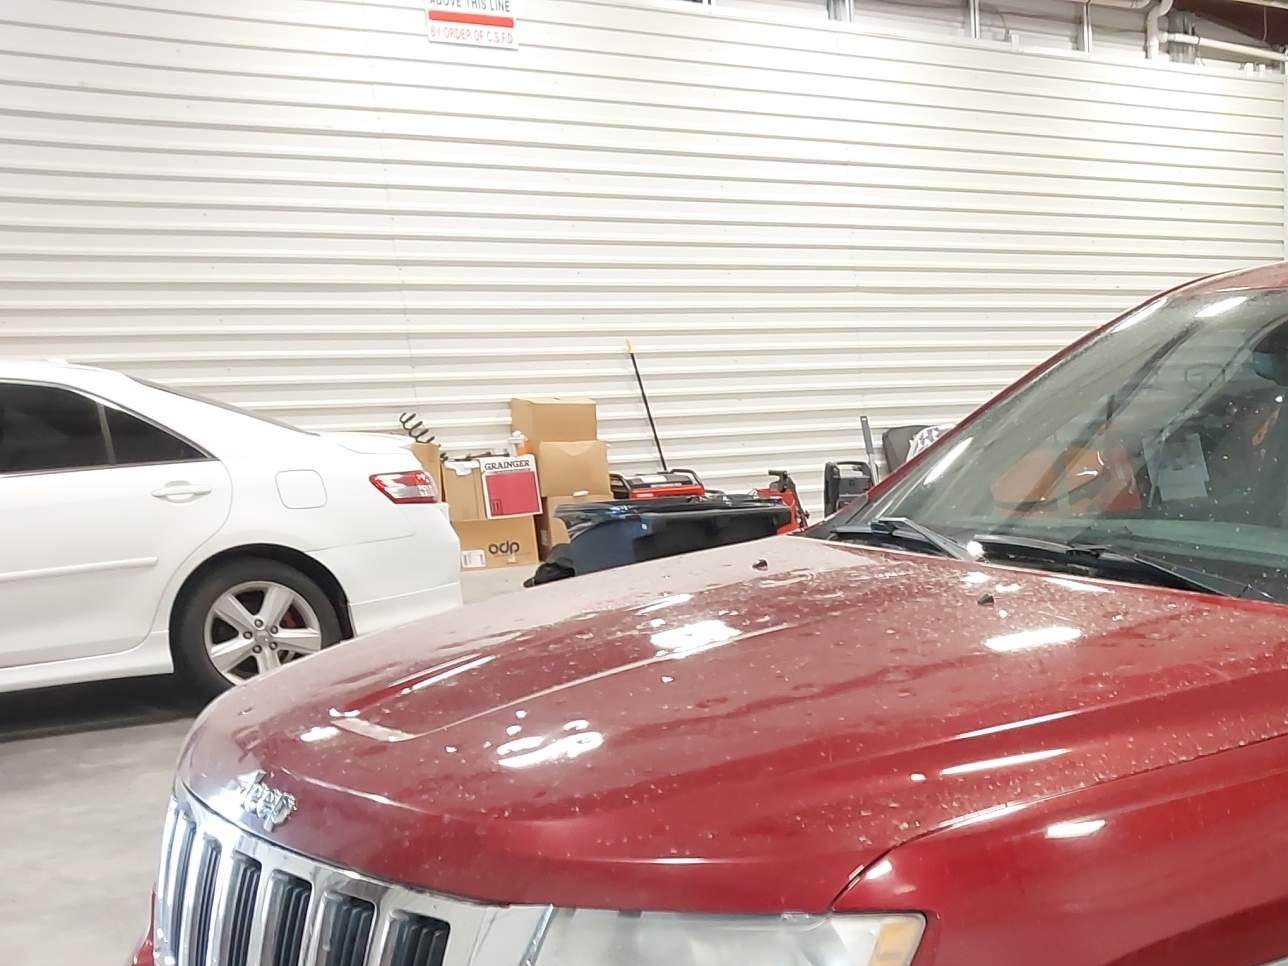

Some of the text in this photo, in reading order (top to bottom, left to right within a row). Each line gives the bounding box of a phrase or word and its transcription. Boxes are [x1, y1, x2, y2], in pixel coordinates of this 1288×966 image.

[490, 0, 512, 13] LINE
[443, 26, 472, 40] ORDER
[474, 29, 484, 42] OF
[484, 459, 530, 471] GRAINGER
[488, 540, 520, 555] odp
